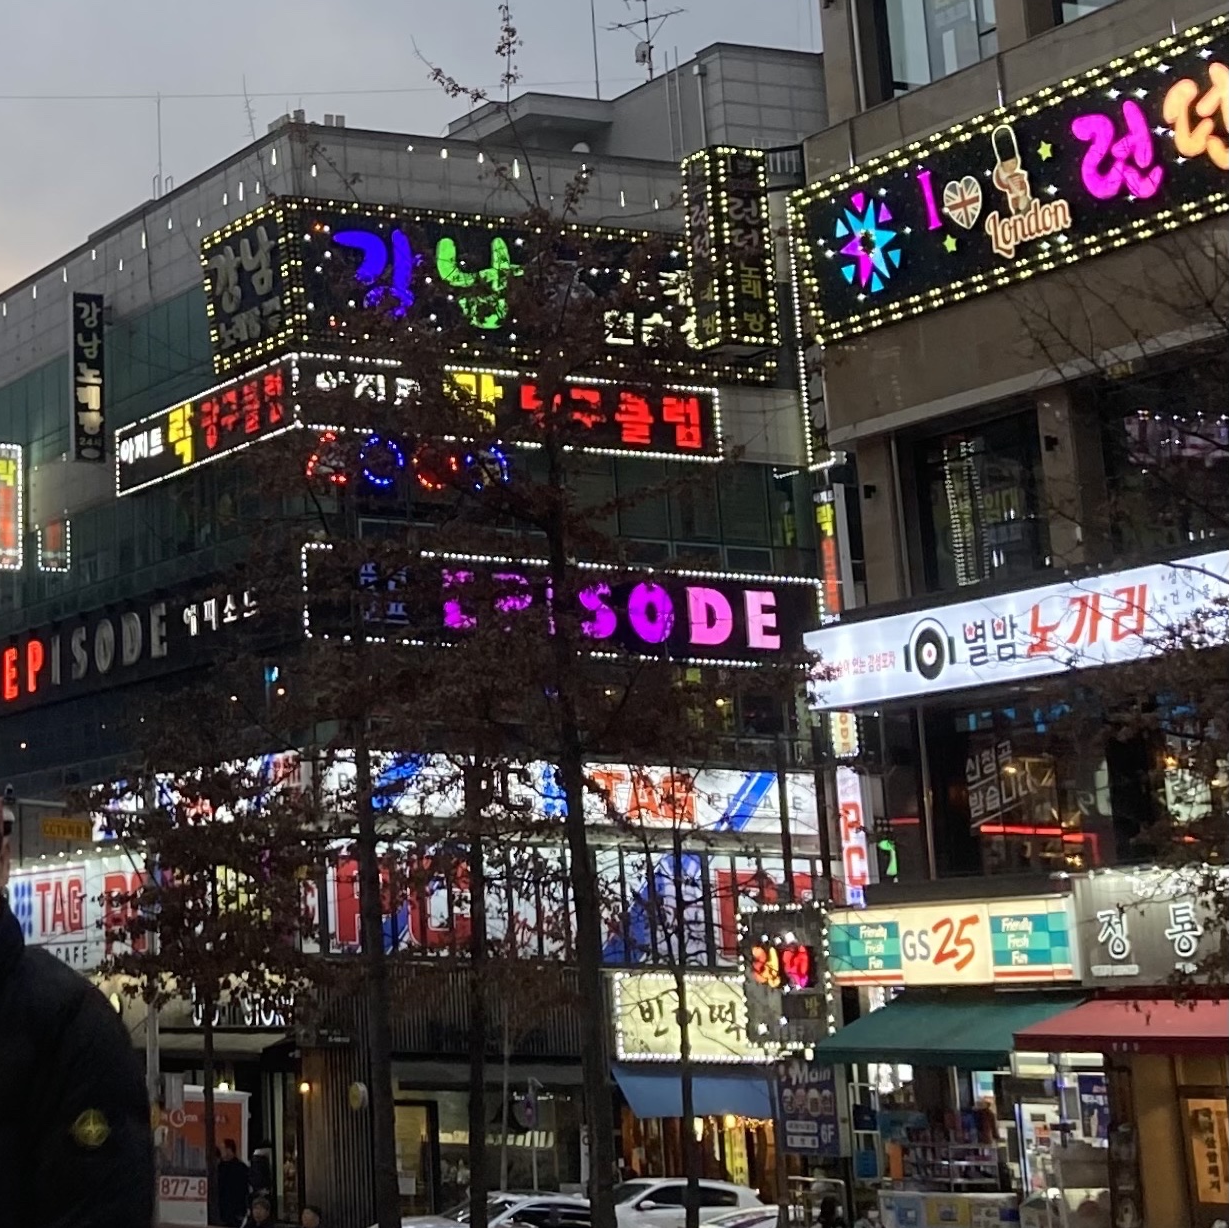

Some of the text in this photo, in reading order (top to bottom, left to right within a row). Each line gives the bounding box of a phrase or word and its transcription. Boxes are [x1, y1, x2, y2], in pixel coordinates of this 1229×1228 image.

[984, 199, 1072, 259] London
[206, 226, 275, 315] 강남
[330, 227, 525, 331] 강남
[118, 414, 164, 463] 아지트
[2, 586, 258, 700] EPISODE 에피소드
[962, 582, 1150, 667] 별밤 노가리
[591, 767, 698, 823] TAG
[841, 802, 869, 885] PC
[35, 867, 86, 939] TAG
[1001, 917, 1033, 934] Friendly
[859, 925, 888, 941] Friendly
[864, 940, 885, 955] Fresh
[901, 914, 980, 972] GS25
[1007, 933, 1030, 949] Fresh
[1011, 950, 1028, 966] Fun
[868, 955, 884, 970] Fun
